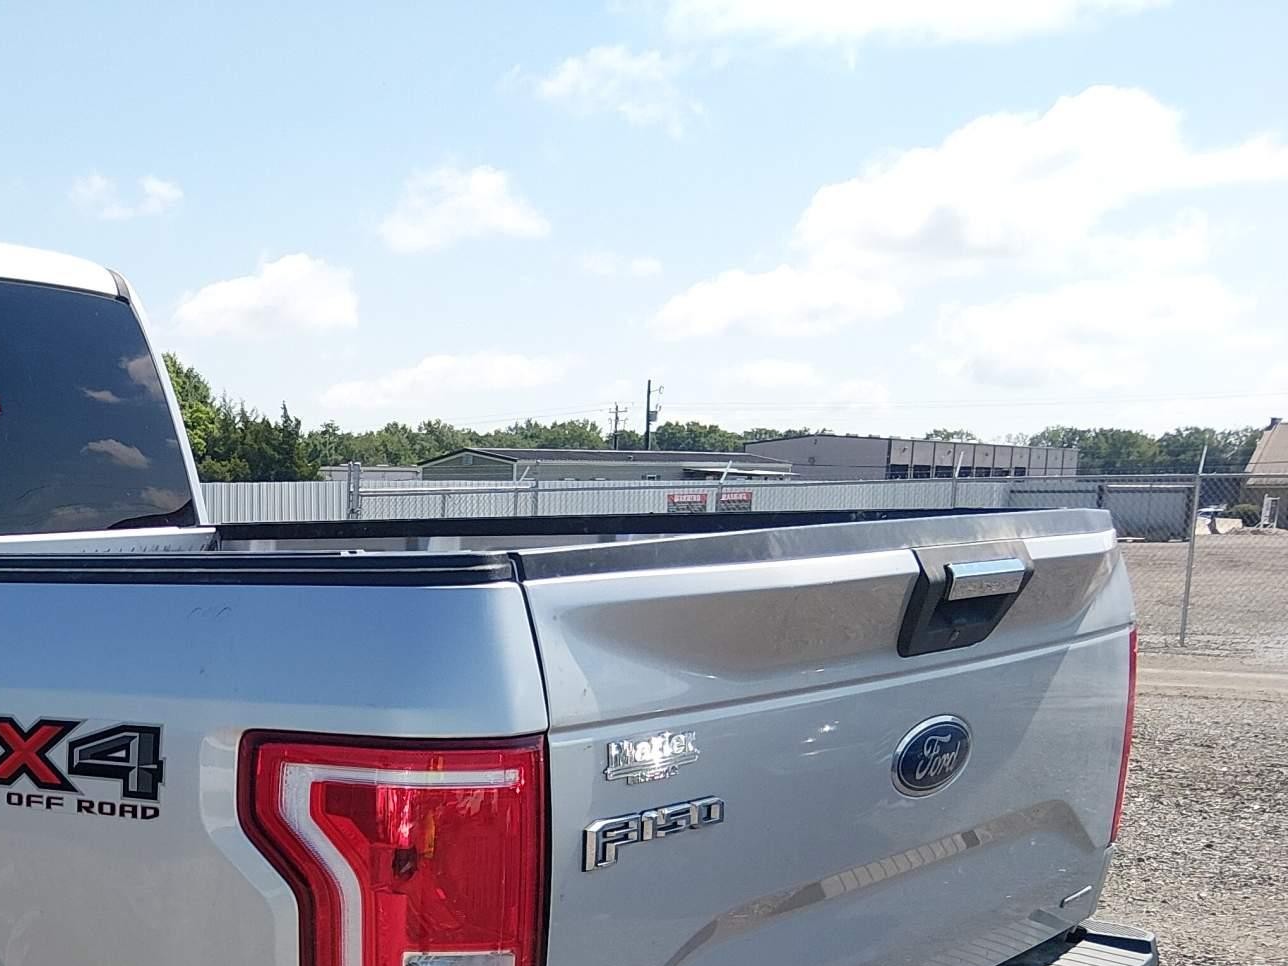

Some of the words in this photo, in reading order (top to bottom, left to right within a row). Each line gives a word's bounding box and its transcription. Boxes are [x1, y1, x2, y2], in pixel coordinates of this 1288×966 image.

[915, 733, 961, 780] Ford
[6, 792, 64, 810] OFF
[76, 799, 160, 820] ROAD
